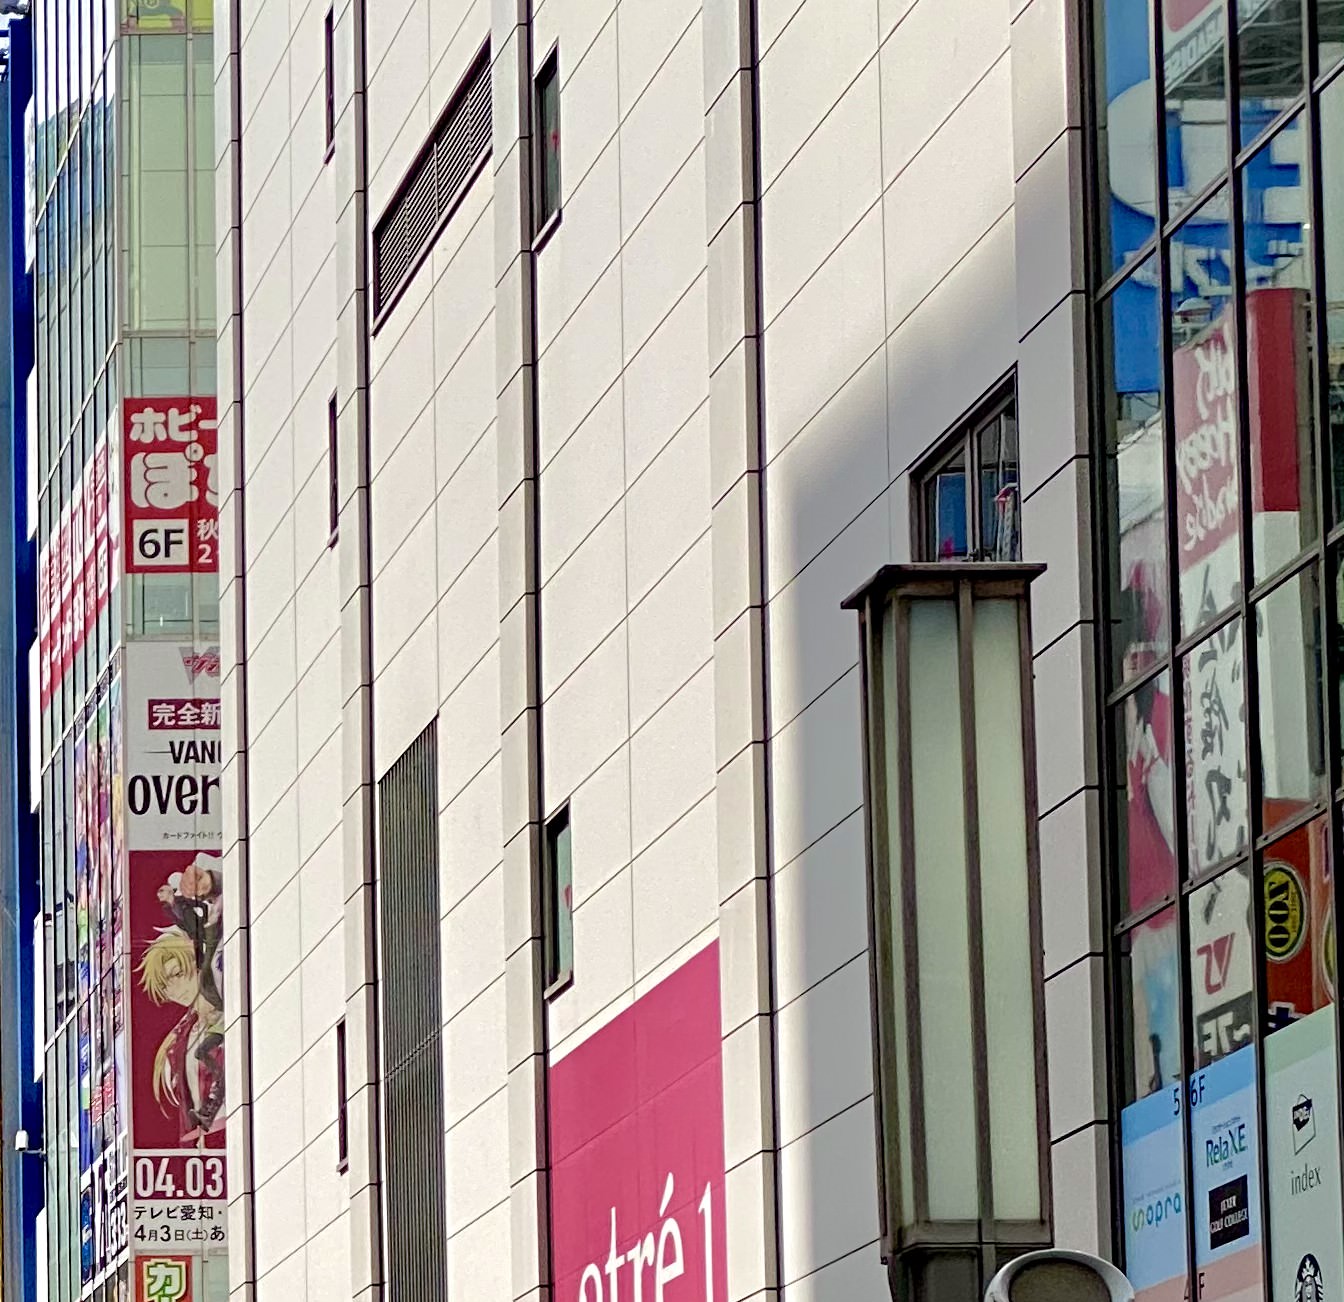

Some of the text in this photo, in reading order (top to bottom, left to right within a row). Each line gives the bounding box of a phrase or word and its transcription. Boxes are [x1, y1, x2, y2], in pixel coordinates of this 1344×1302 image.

[138, 527, 185, 560] 6F
[168, 739, 223, 765] VAN
[135, 1156, 224, 1198] 04.03
[1290, 1162, 1322, 1197] index
